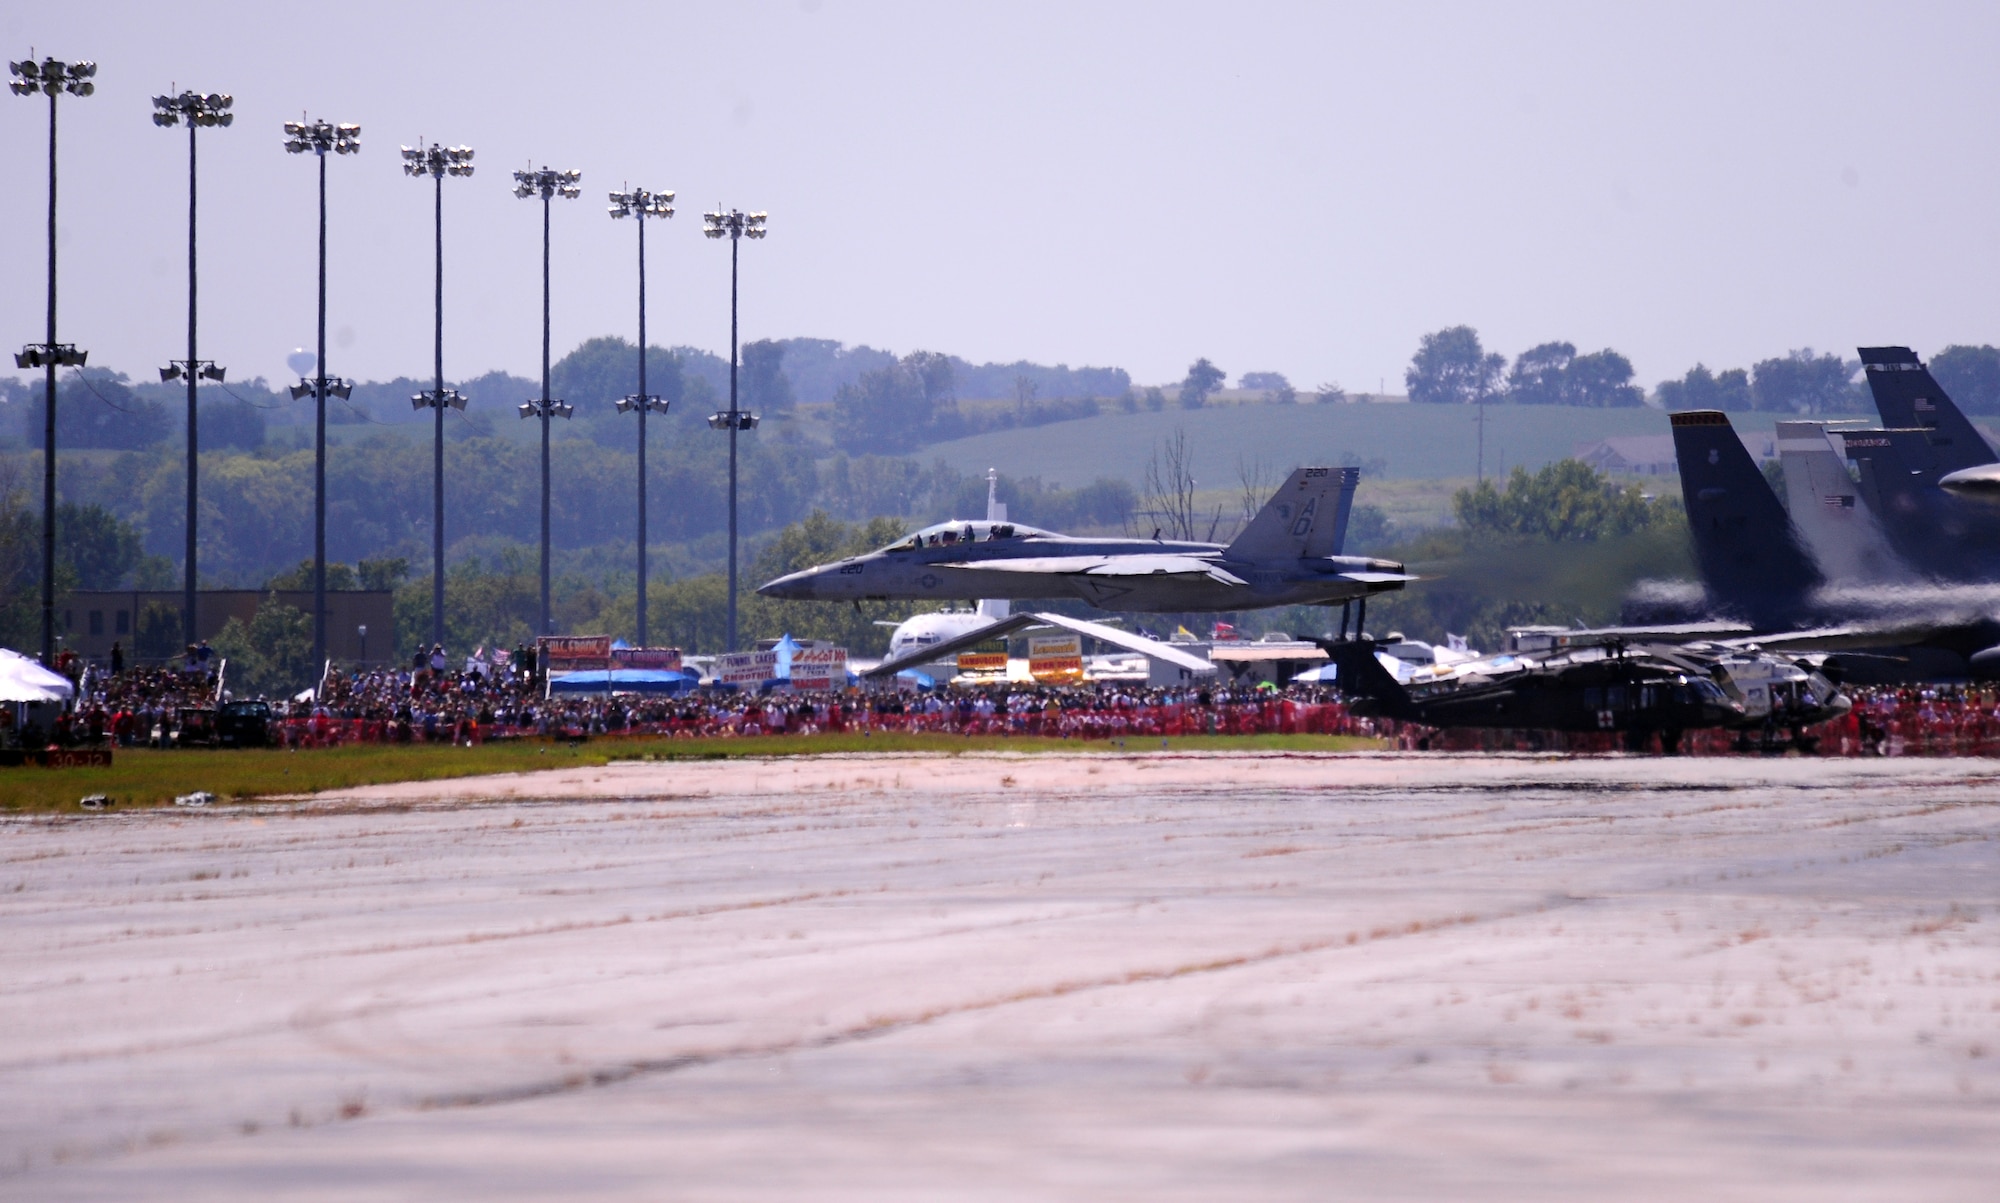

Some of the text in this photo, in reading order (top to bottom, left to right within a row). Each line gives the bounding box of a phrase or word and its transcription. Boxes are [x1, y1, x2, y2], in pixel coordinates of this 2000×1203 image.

[1845, 438, 1891, 448] NEBRASKA
[1305, 468, 1329, 478] 220
[840, 564, 864, 575] 220
[1253, 572, 1288, 584] NAVY
[727, 652, 776, 667] FUNNEL CAKES
[959, 656, 1004, 665] HAMBURGERS
[1057, 659, 1079, 669] DOGS
[54, 753, 104, 769] 30-12
